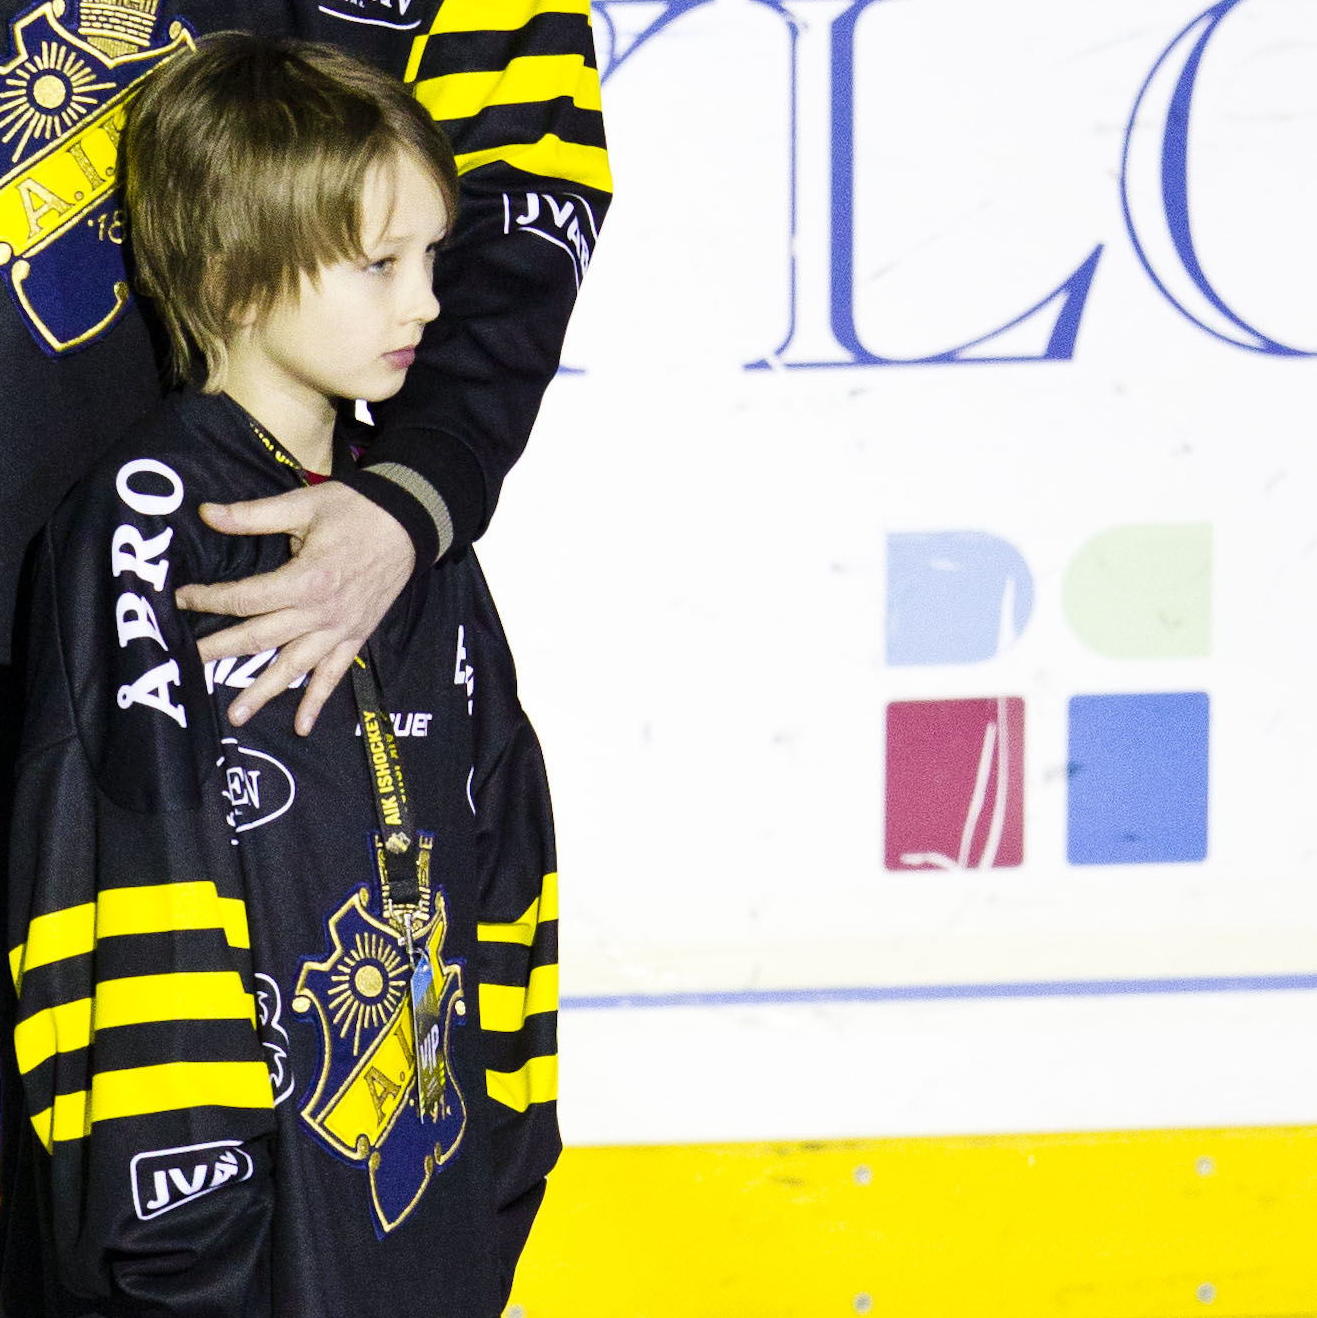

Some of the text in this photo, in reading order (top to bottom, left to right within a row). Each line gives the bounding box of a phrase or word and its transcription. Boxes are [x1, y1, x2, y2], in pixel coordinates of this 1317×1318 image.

[363, 709, 396, 794] ISHOCKEY
[380, 794, 403, 826] AIK
[419, 1023, 440, 1075] VIP
